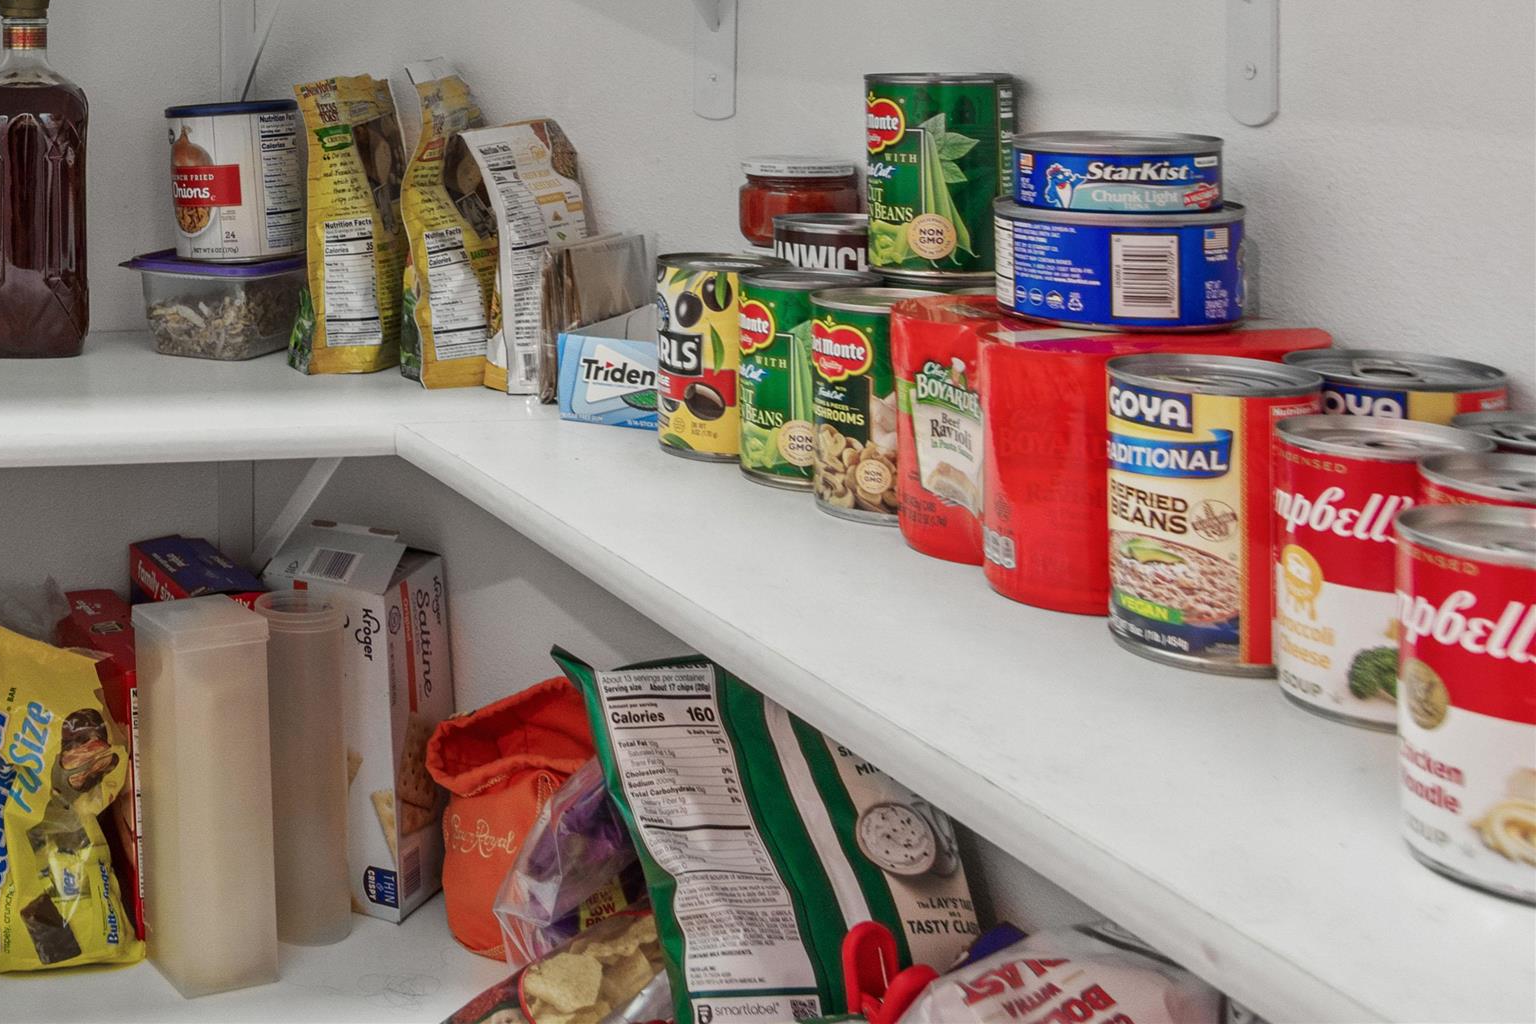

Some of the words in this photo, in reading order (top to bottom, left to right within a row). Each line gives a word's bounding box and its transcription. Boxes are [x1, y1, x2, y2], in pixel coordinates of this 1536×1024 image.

[259, 114, 286, 123] Nutrition
[261, 142, 286, 150] Calories
[884, 152, 917, 163] WITH
[1087, 161, 1189, 181] StarKist
[172, 182, 210, 199] Onions
[1091, 189, 1143, 204] Chunk
[1145, 188, 1179, 205] Light
[874, 203, 914, 223] BEANS
[324, 220, 353, 230] Nutrition
[354, 219, 372, 227] Facts
[919, 228, 944, 237] NON
[224, 231, 236, 239] 24
[919, 236, 945, 245] GMO
[325, 246, 349, 254] Calories
[428, 257, 451, 266] Calories
[823, 339, 866, 361] Monte
[755, 355, 788, 369] WITH
[582, 358, 656, 387] Triden
[915, 373, 983, 418] BOYARDEE
[1108, 385, 1188, 427] GOYA
[745, 406, 784, 426] BEANS
[788, 434, 813, 443] NON
[930, 419, 973, 452] Ravioli
[788, 442, 814, 452] GMO
[432, 575, 443, 626] Kroger
[1119, 594, 1169, 620] VEGAN
[354, 607, 381, 662] Kroger
[415, 590, 434, 699] Saltine
[6, 686, 17, 704] BAR
[603, 685, 629, 694] Serving
[611, 710, 665, 724] Calories
[686, 706, 715, 722] 160
[618, 741, 637, 749] Total
[625, 768, 665, 779] Cholesterol
[628, 780, 655, 789] Sodium
[649, 786, 696, 796] Carbohydrate
[366, 869, 377, 902] CRISPY
[384, 872, 396, 905] THIN
[929, 895, 958, 911] LAY'S
[907, 919, 951, 935] TASTY
[714, 1002, 778, 1018] smartlabel
